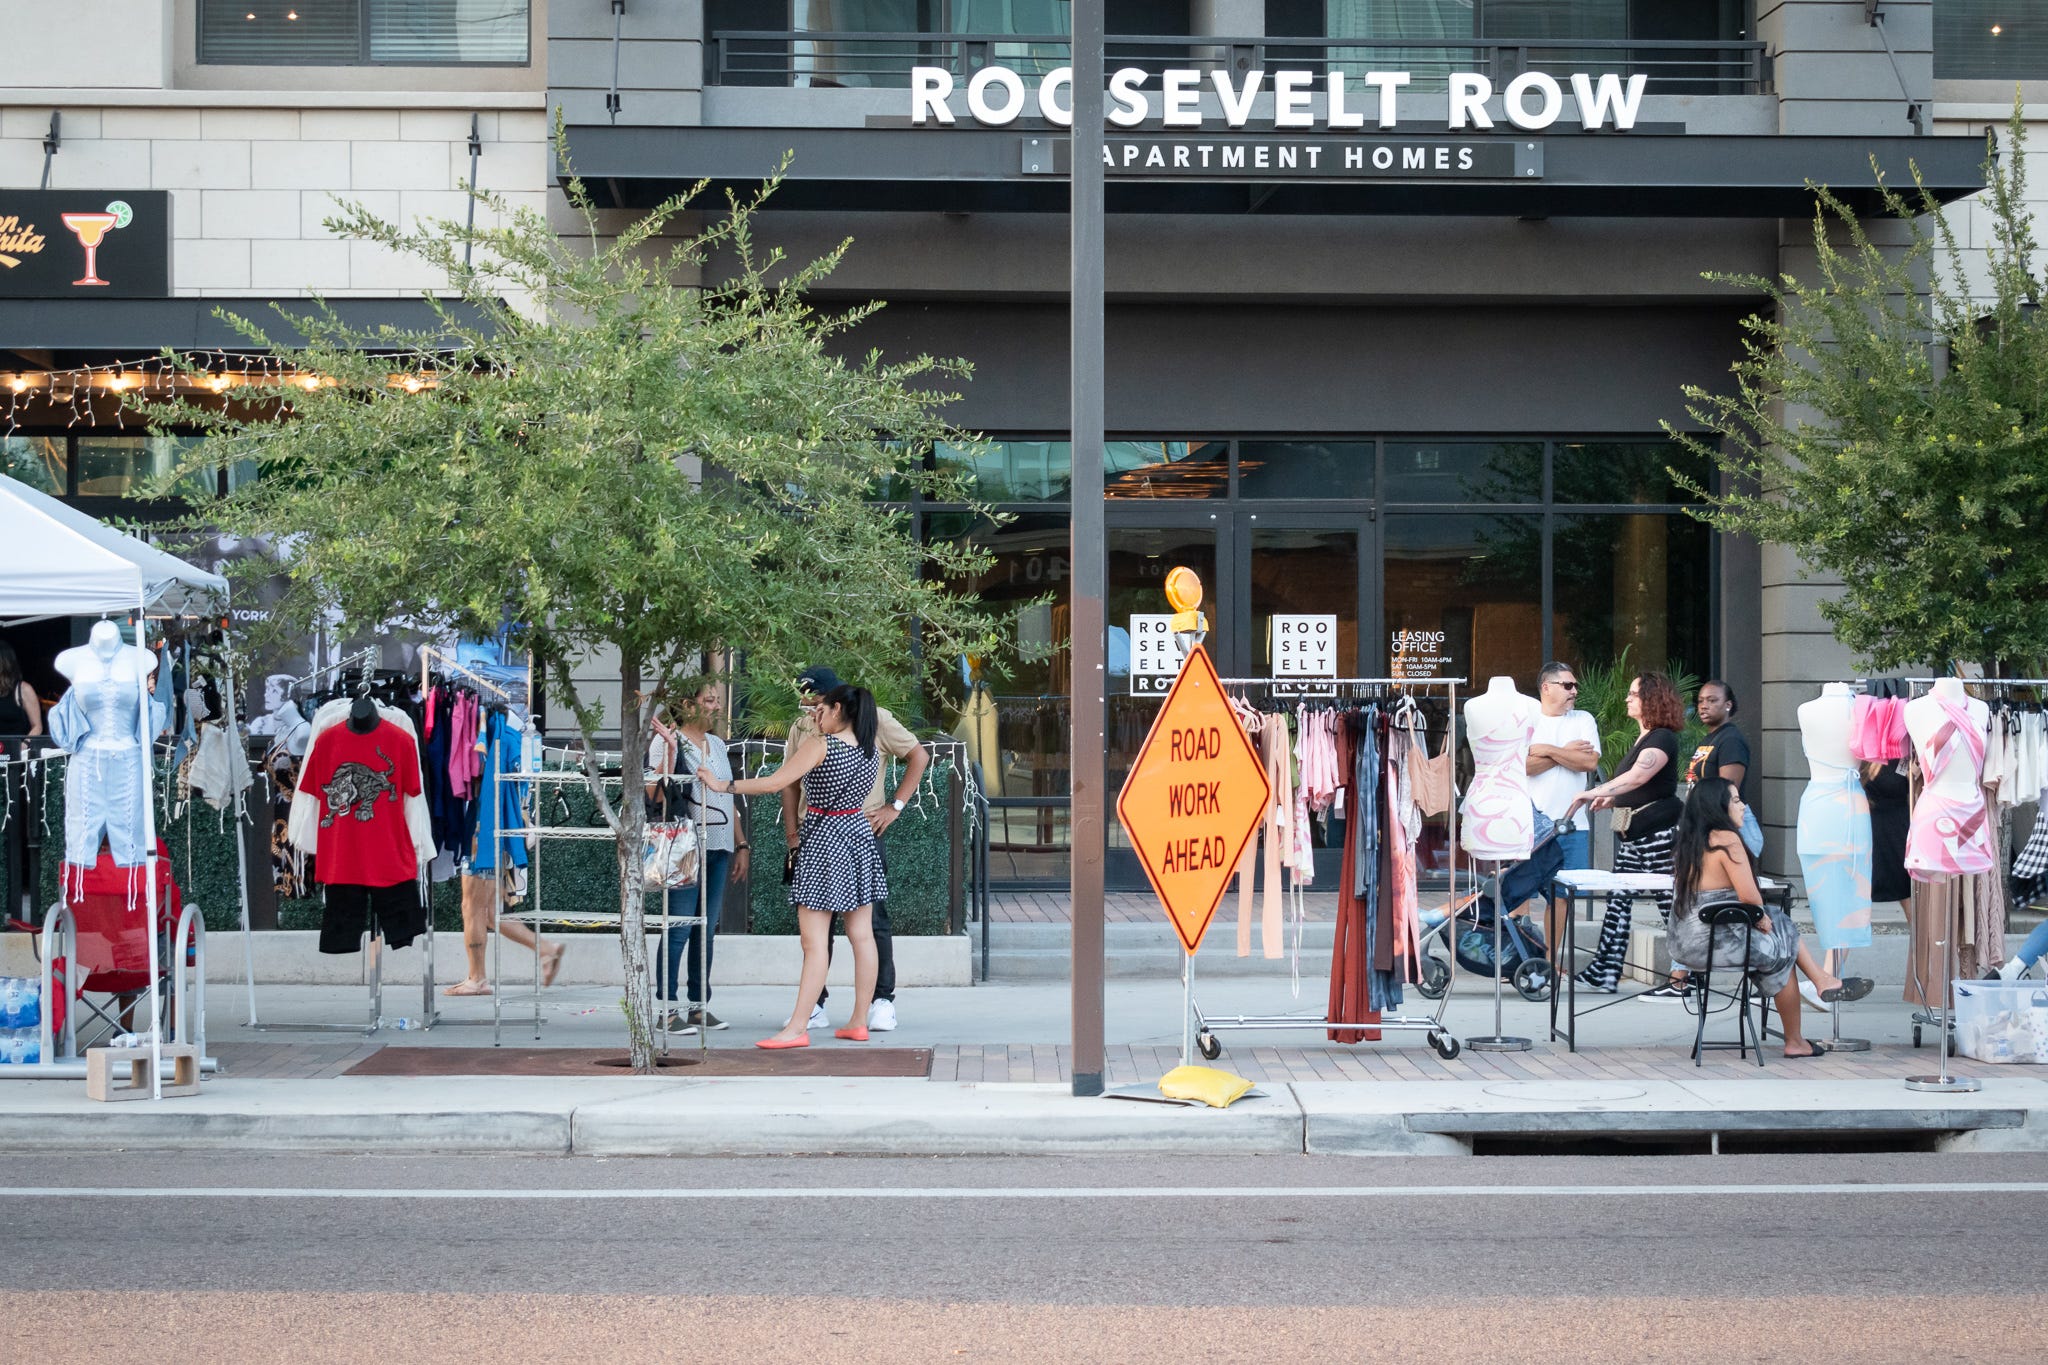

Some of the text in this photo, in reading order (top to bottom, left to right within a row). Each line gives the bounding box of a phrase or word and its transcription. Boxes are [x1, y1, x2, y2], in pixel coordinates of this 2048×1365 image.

[911, 65, 1648, 131] ROOSEVELT ROW
[1103, 144, 1474, 170] APARTMENT HOMES
[1139, 621, 1167, 634] RO
[1281, 622, 1328, 634] ROO
[1392, 631, 1445, 642] LEASING
[1282, 640, 1327, 652] SEV
[1391, 641, 1437, 652] OFFICE
[1139, 658, 1184, 670] ELT
[1282, 658, 1326, 670] ELT
[1139, 677, 1167, 691] RO
[1171, 727, 1221, 762] ROAD
[1169, 781, 1221, 818] WORK
[1162, 835, 1226, 875] AHEAD
